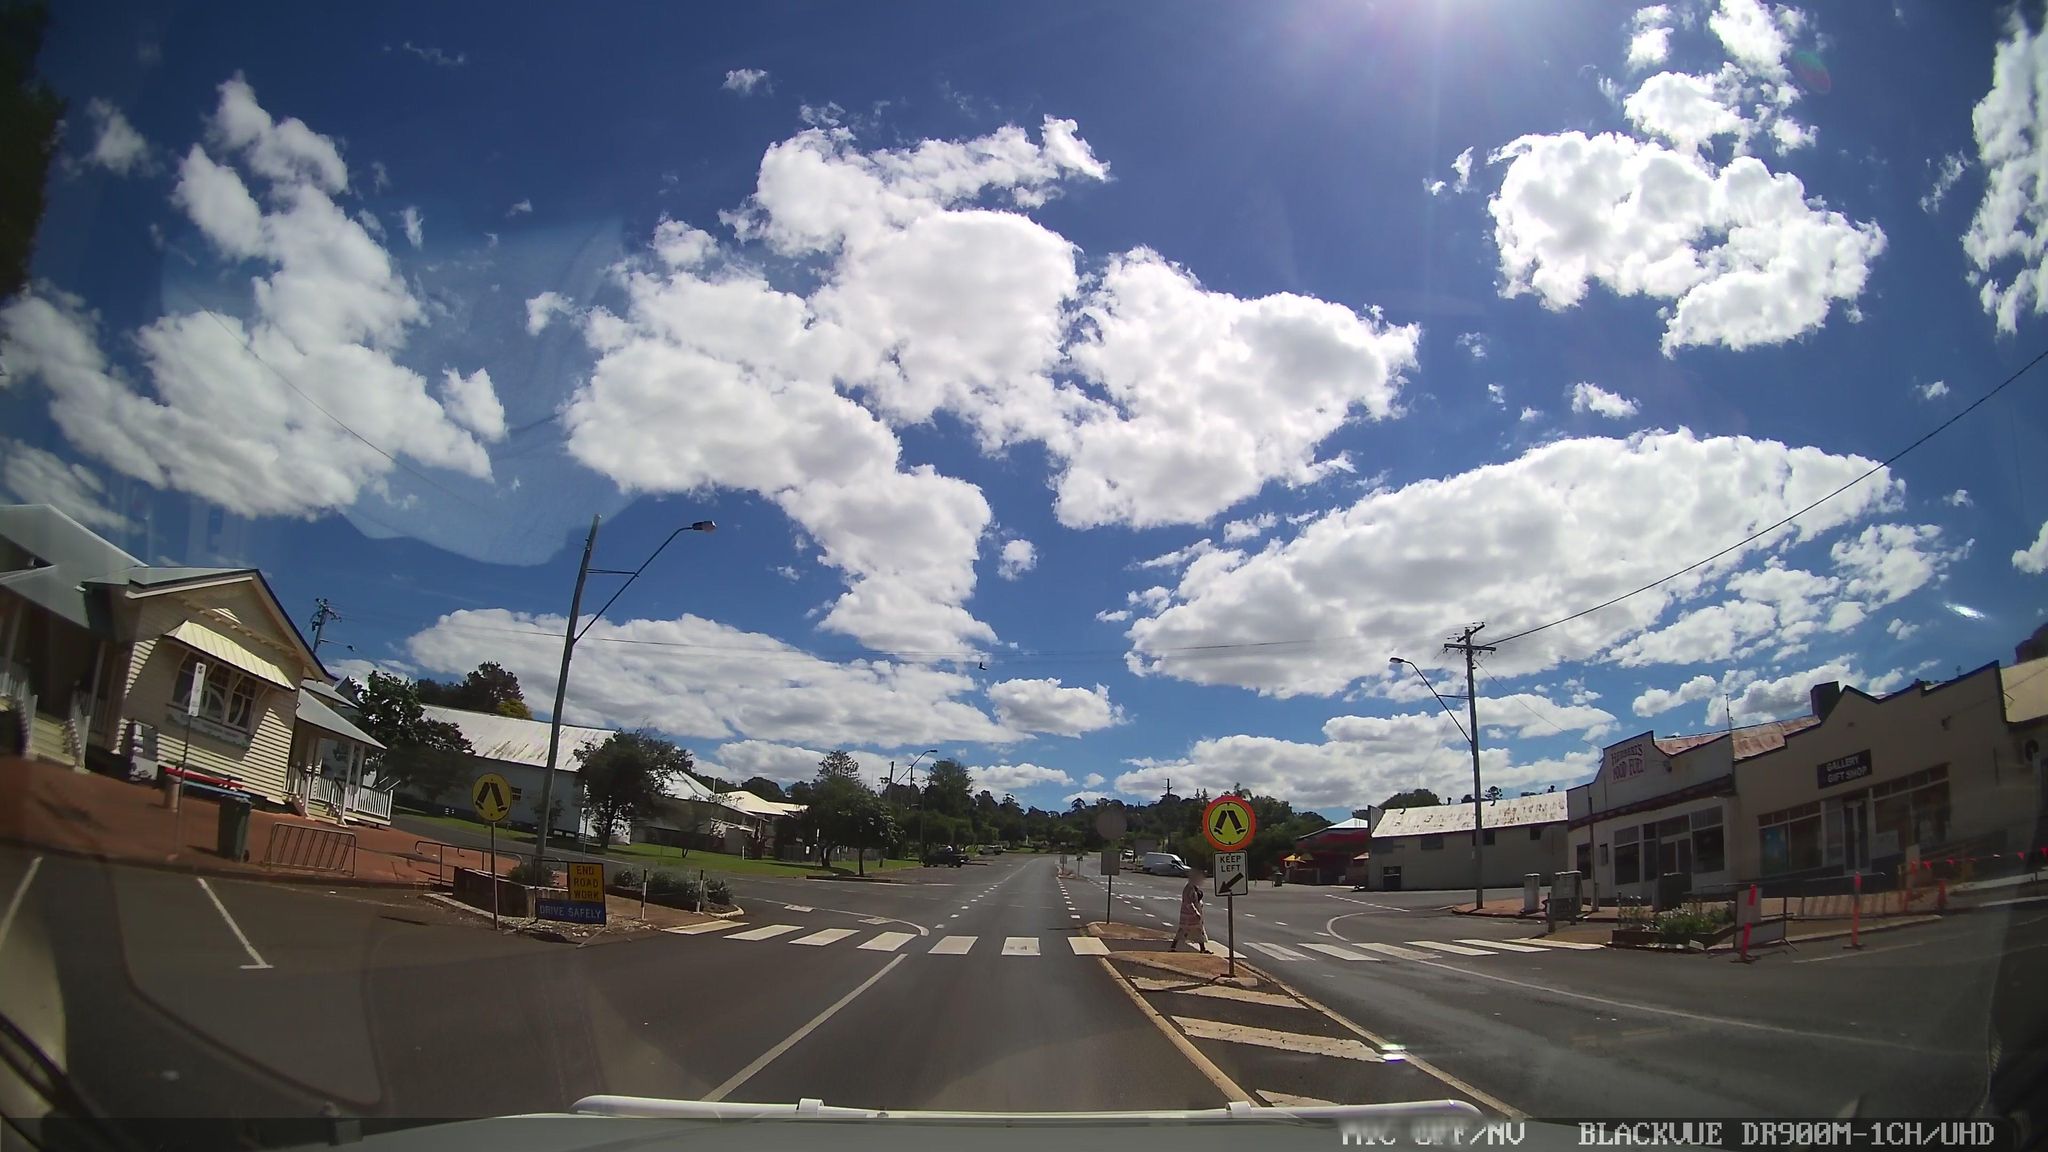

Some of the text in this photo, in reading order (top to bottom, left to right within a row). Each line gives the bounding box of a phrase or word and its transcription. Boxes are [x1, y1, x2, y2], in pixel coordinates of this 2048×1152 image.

[1826, 755, 1859, 771] GALLERY
[1827, 766, 1867, 783] GIFT SHOP
[1219, 855, 1242, 863] KEEP
[576, 865, 594, 875] END
[1220, 864, 1241, 873] LEFT
[573, 877, 599, 888] ROAD
[573, 890, 599, 899] WORK
[539, 904, 602, 919] DRIVE SAFELY
